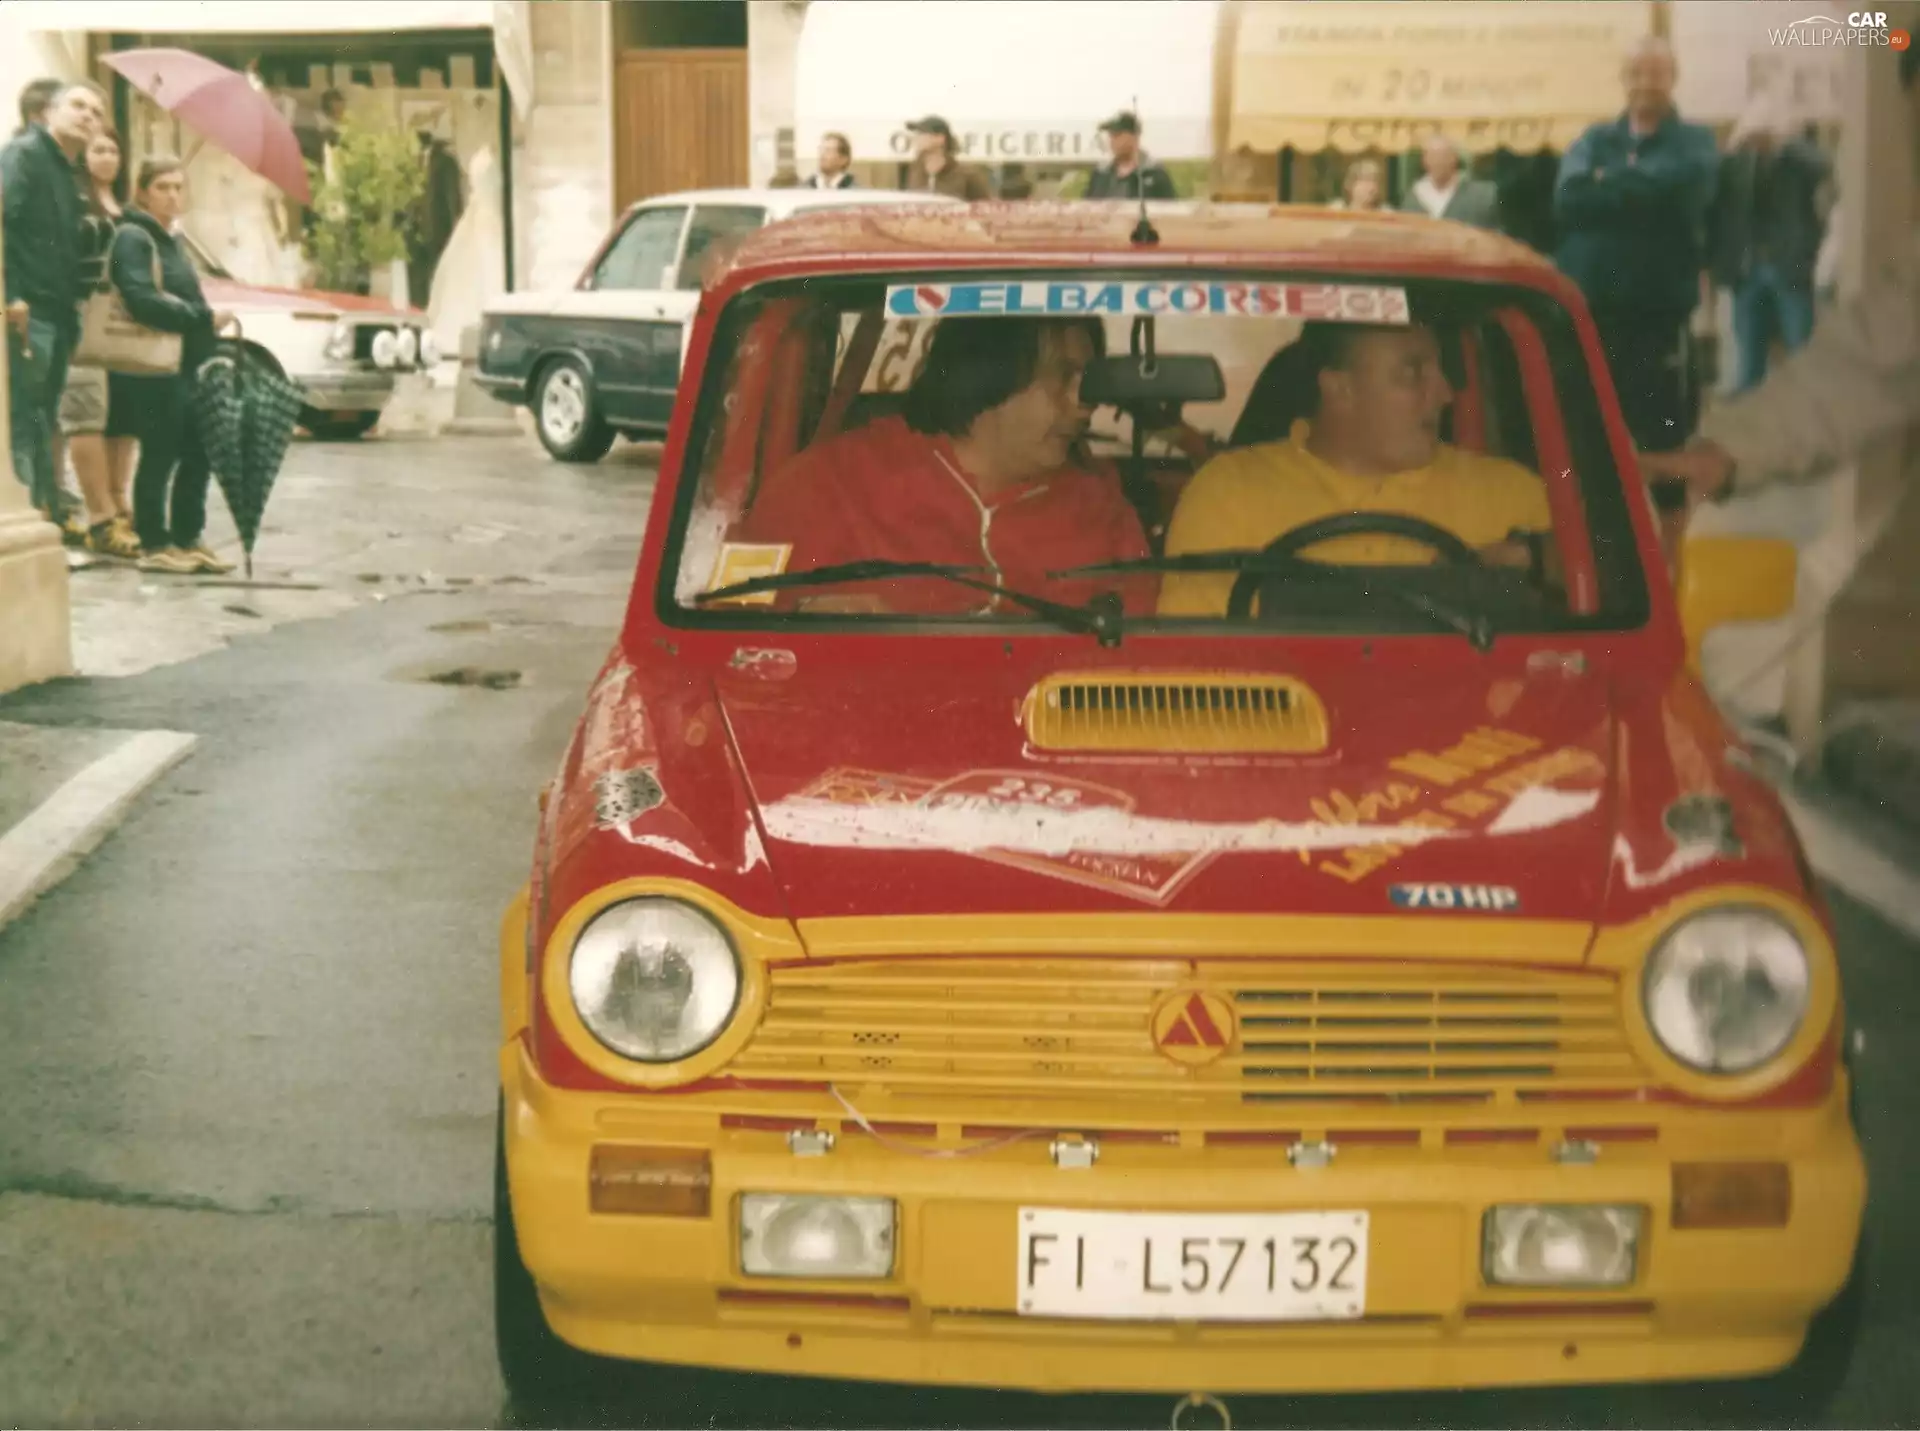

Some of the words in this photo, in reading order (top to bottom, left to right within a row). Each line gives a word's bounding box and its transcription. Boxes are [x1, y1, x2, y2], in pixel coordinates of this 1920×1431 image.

[1382, 68, 1431, 102] 20
[954, 283, 1124, 315] ELBA
[1135, 283, 1328, 318] CORSE
[1400, 883, 1455, 908] 70
[1461, 883, 1518, 910] HP
[1142, 1235, 1359, 1294] L57132
